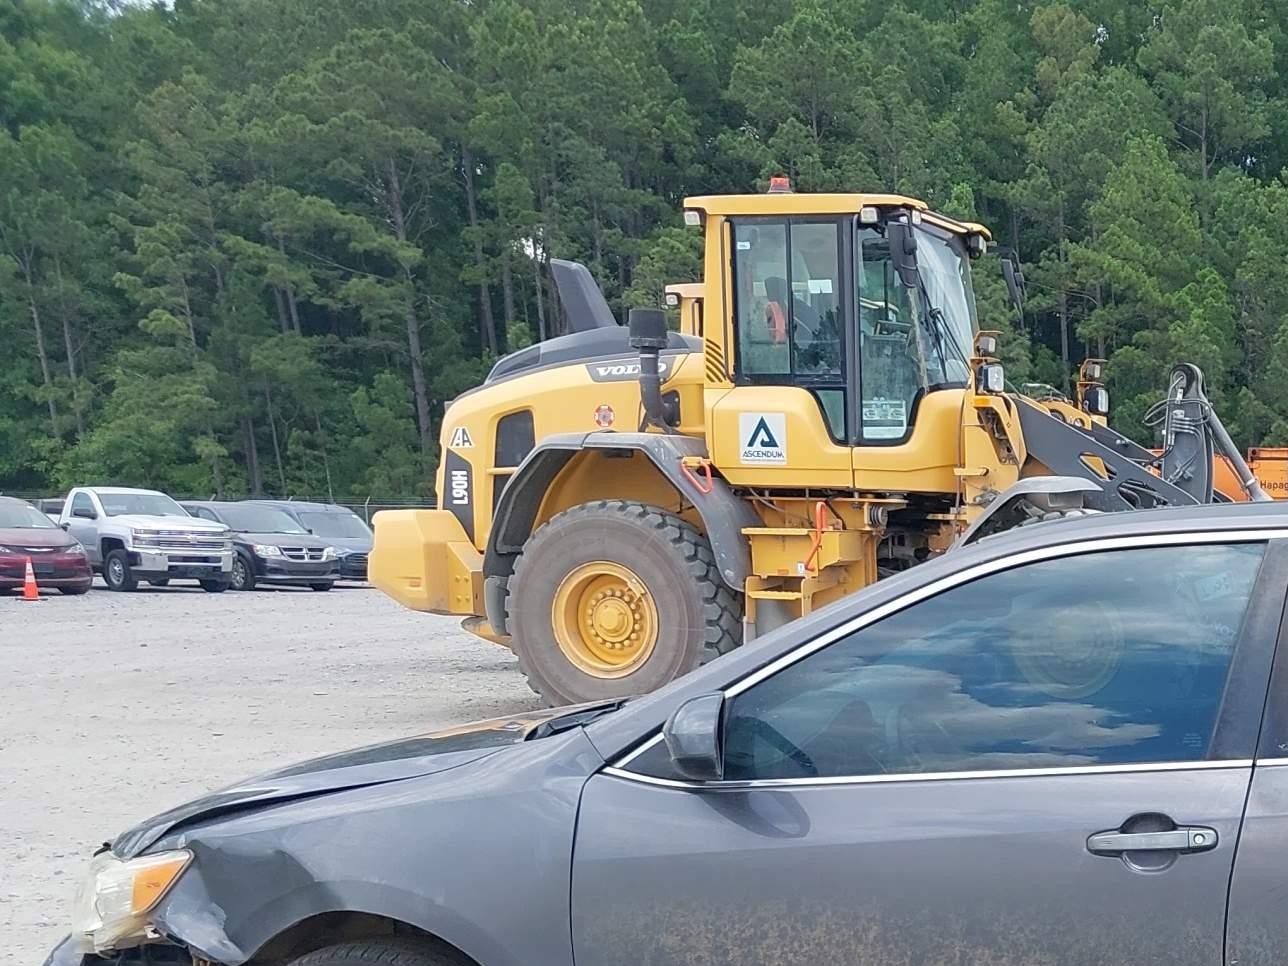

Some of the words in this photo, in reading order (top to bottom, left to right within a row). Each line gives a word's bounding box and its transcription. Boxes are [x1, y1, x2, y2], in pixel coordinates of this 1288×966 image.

[597, 363, 667, 376] VOLO
[743, 450, 785, 458] ASCENDUM
[451, 470, 469, 505] L90H
